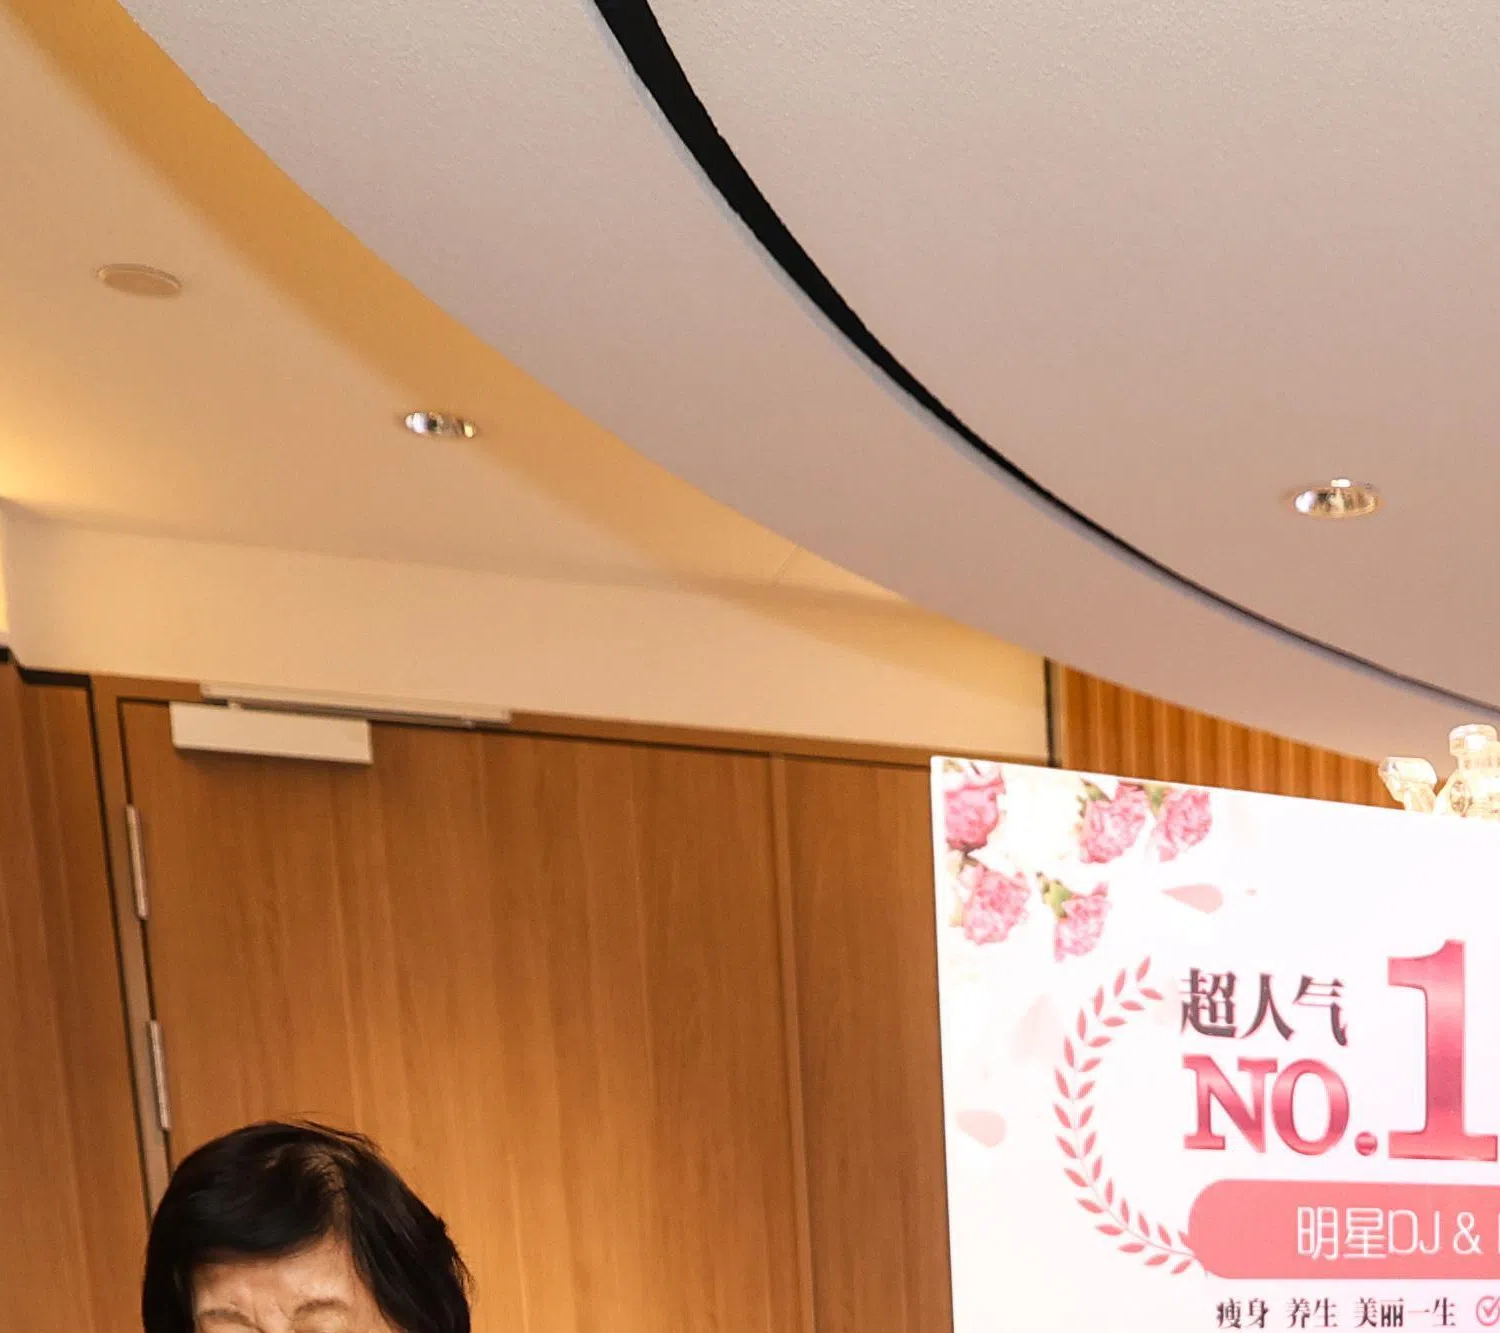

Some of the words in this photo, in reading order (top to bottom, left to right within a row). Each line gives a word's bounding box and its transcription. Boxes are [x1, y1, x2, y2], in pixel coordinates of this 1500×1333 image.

[1180, 967, 1348, 1047] 超人气
[1296, 1205, 1441, 1261] 明星DJ
[1452, 1211, 1483, 1255] &
[1216, 1297, 1269, 1329] 瘦身
[1286, 1297, 1338, 1329] 养生
[1355, 1297, 1456, 1329] 美丽一生
